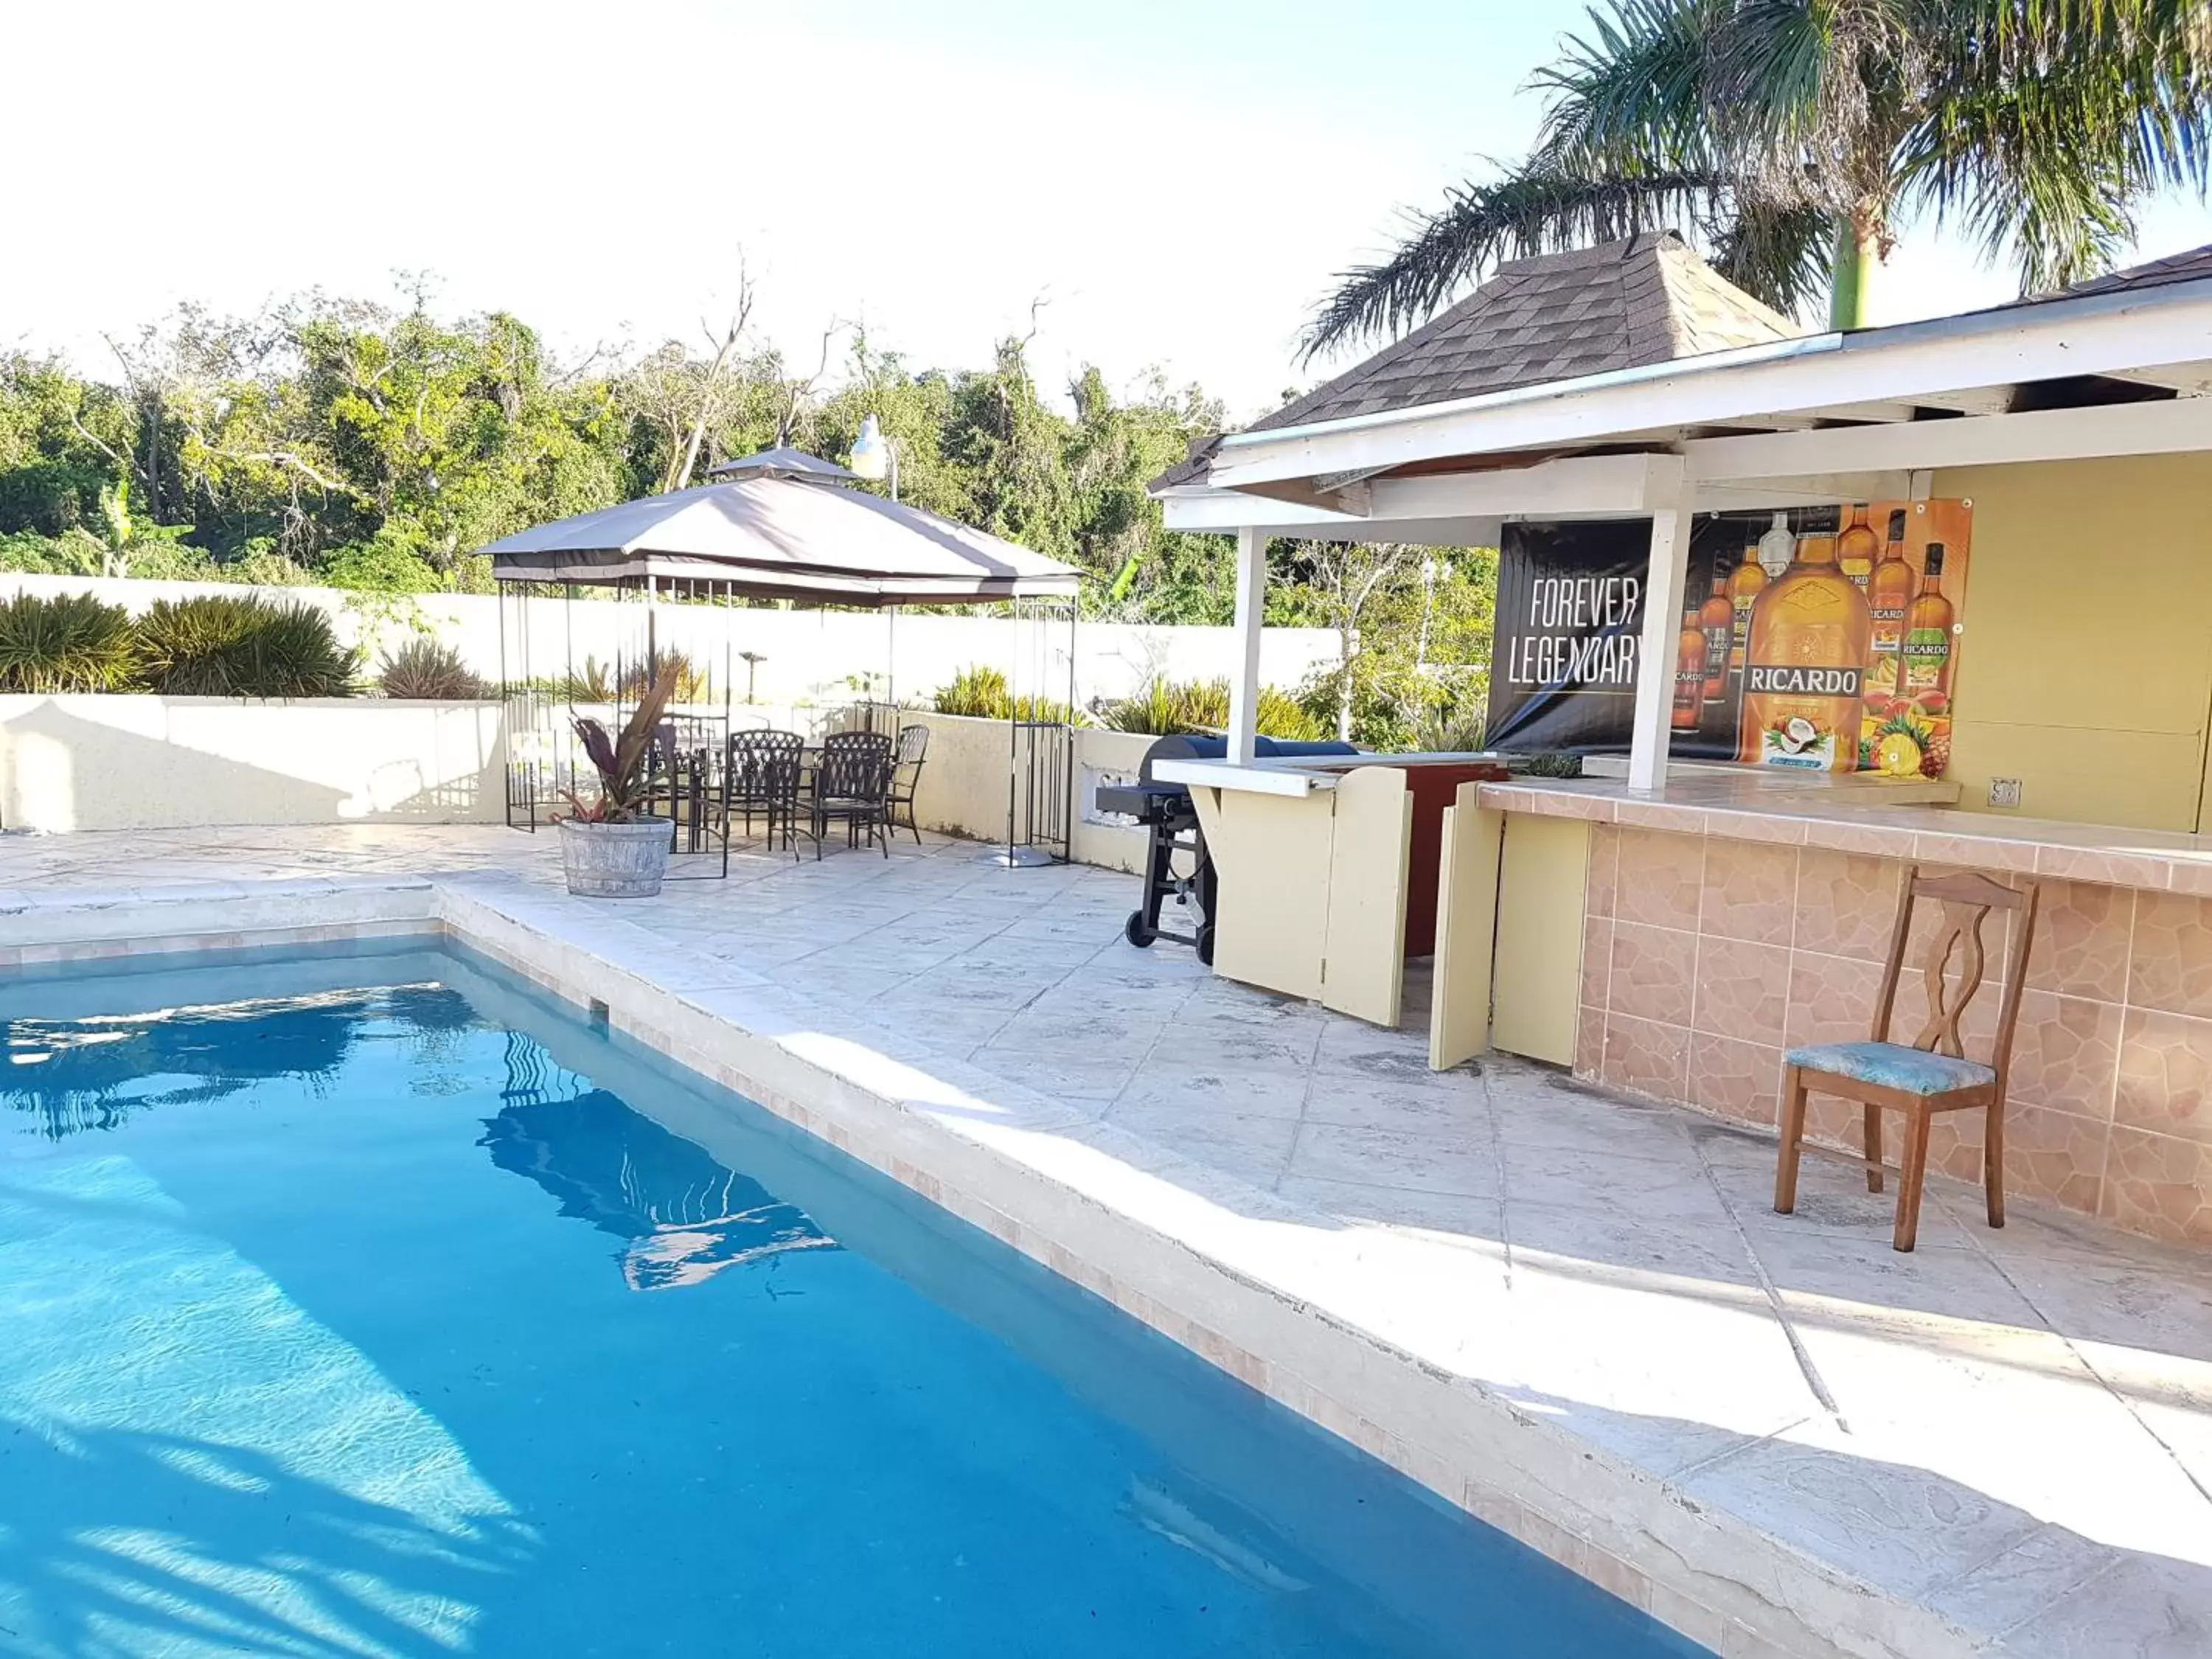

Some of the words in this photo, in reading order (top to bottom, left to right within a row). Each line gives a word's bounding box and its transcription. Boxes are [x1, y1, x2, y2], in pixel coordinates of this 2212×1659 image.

[1530, 577, 1640, 627] FOREVER
[1903, 645, 1948, 655] RICARDO
[1750, 667, 1857, 694] RICARDO
